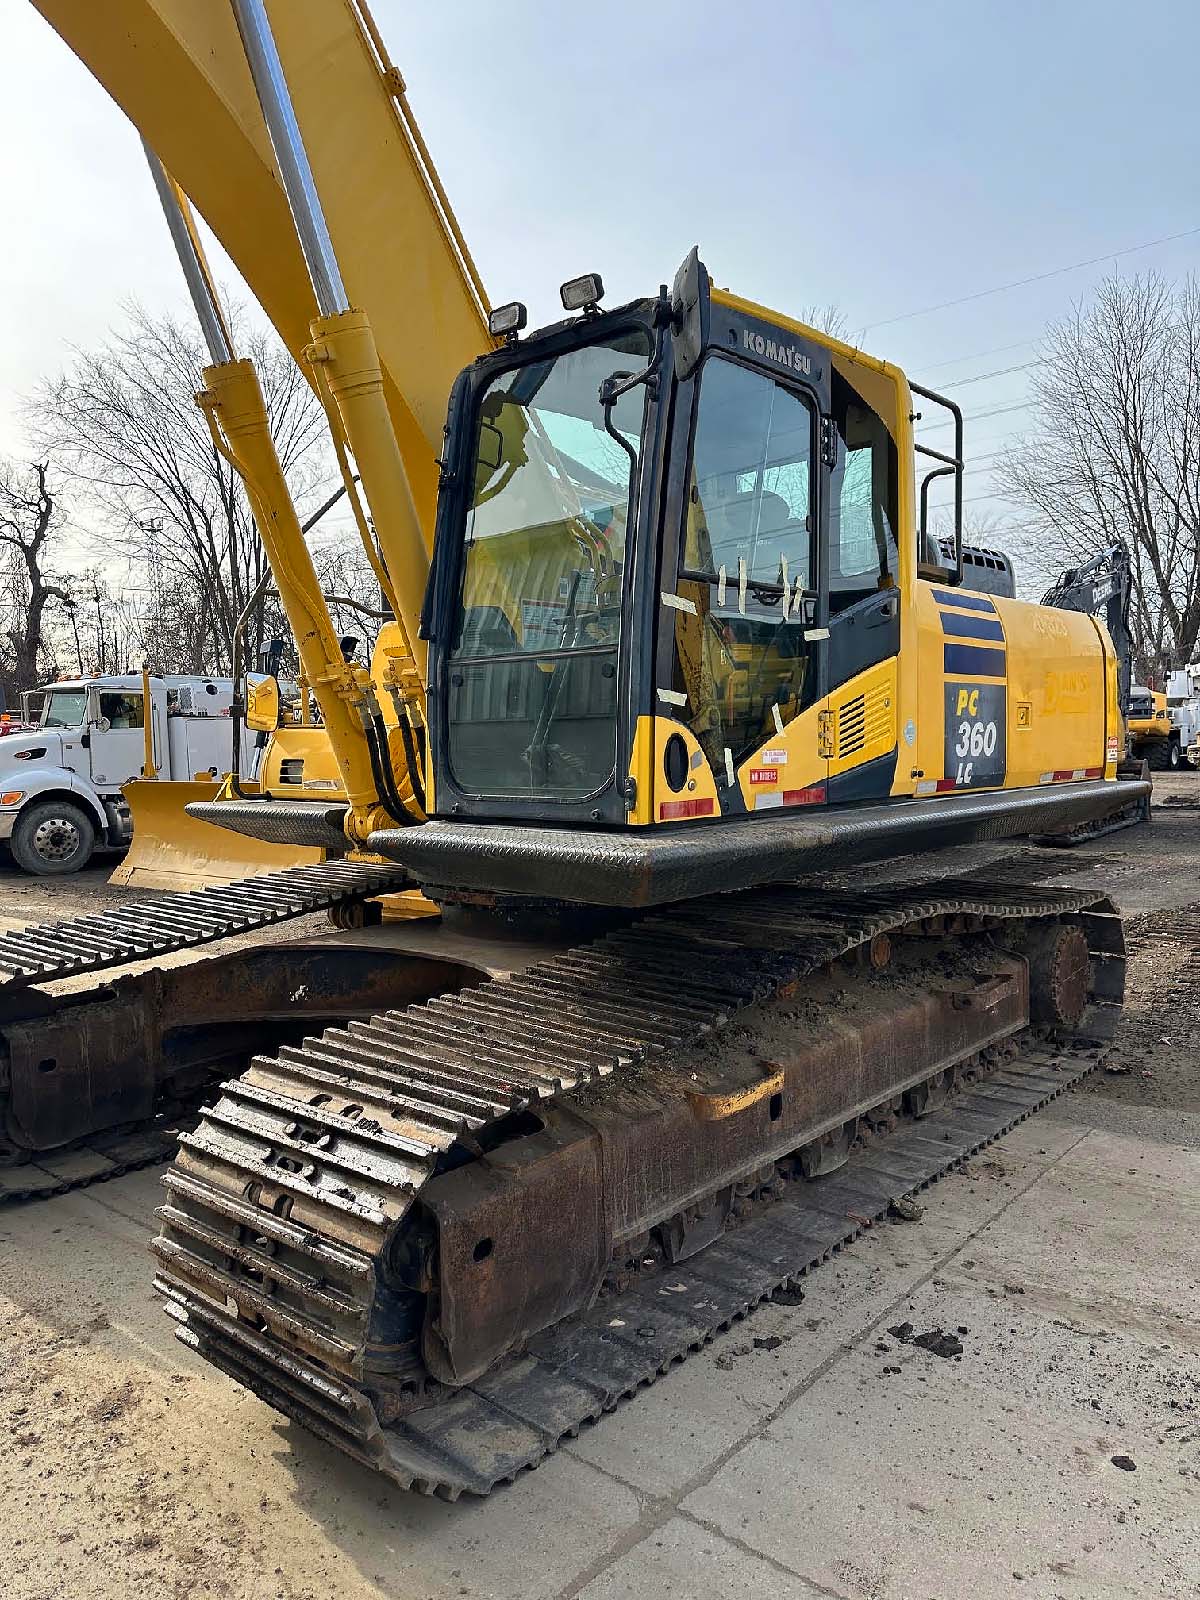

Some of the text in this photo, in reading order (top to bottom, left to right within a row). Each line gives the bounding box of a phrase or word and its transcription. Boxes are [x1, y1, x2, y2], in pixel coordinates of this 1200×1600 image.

[743, 329, 812, 376] KOMATSU
[1092, 580, 1113, 604] DEERE
[956, 689, 979, 717] PC
[956, 721, 997, 758] 360
[955, 762, 973, 784] LC
